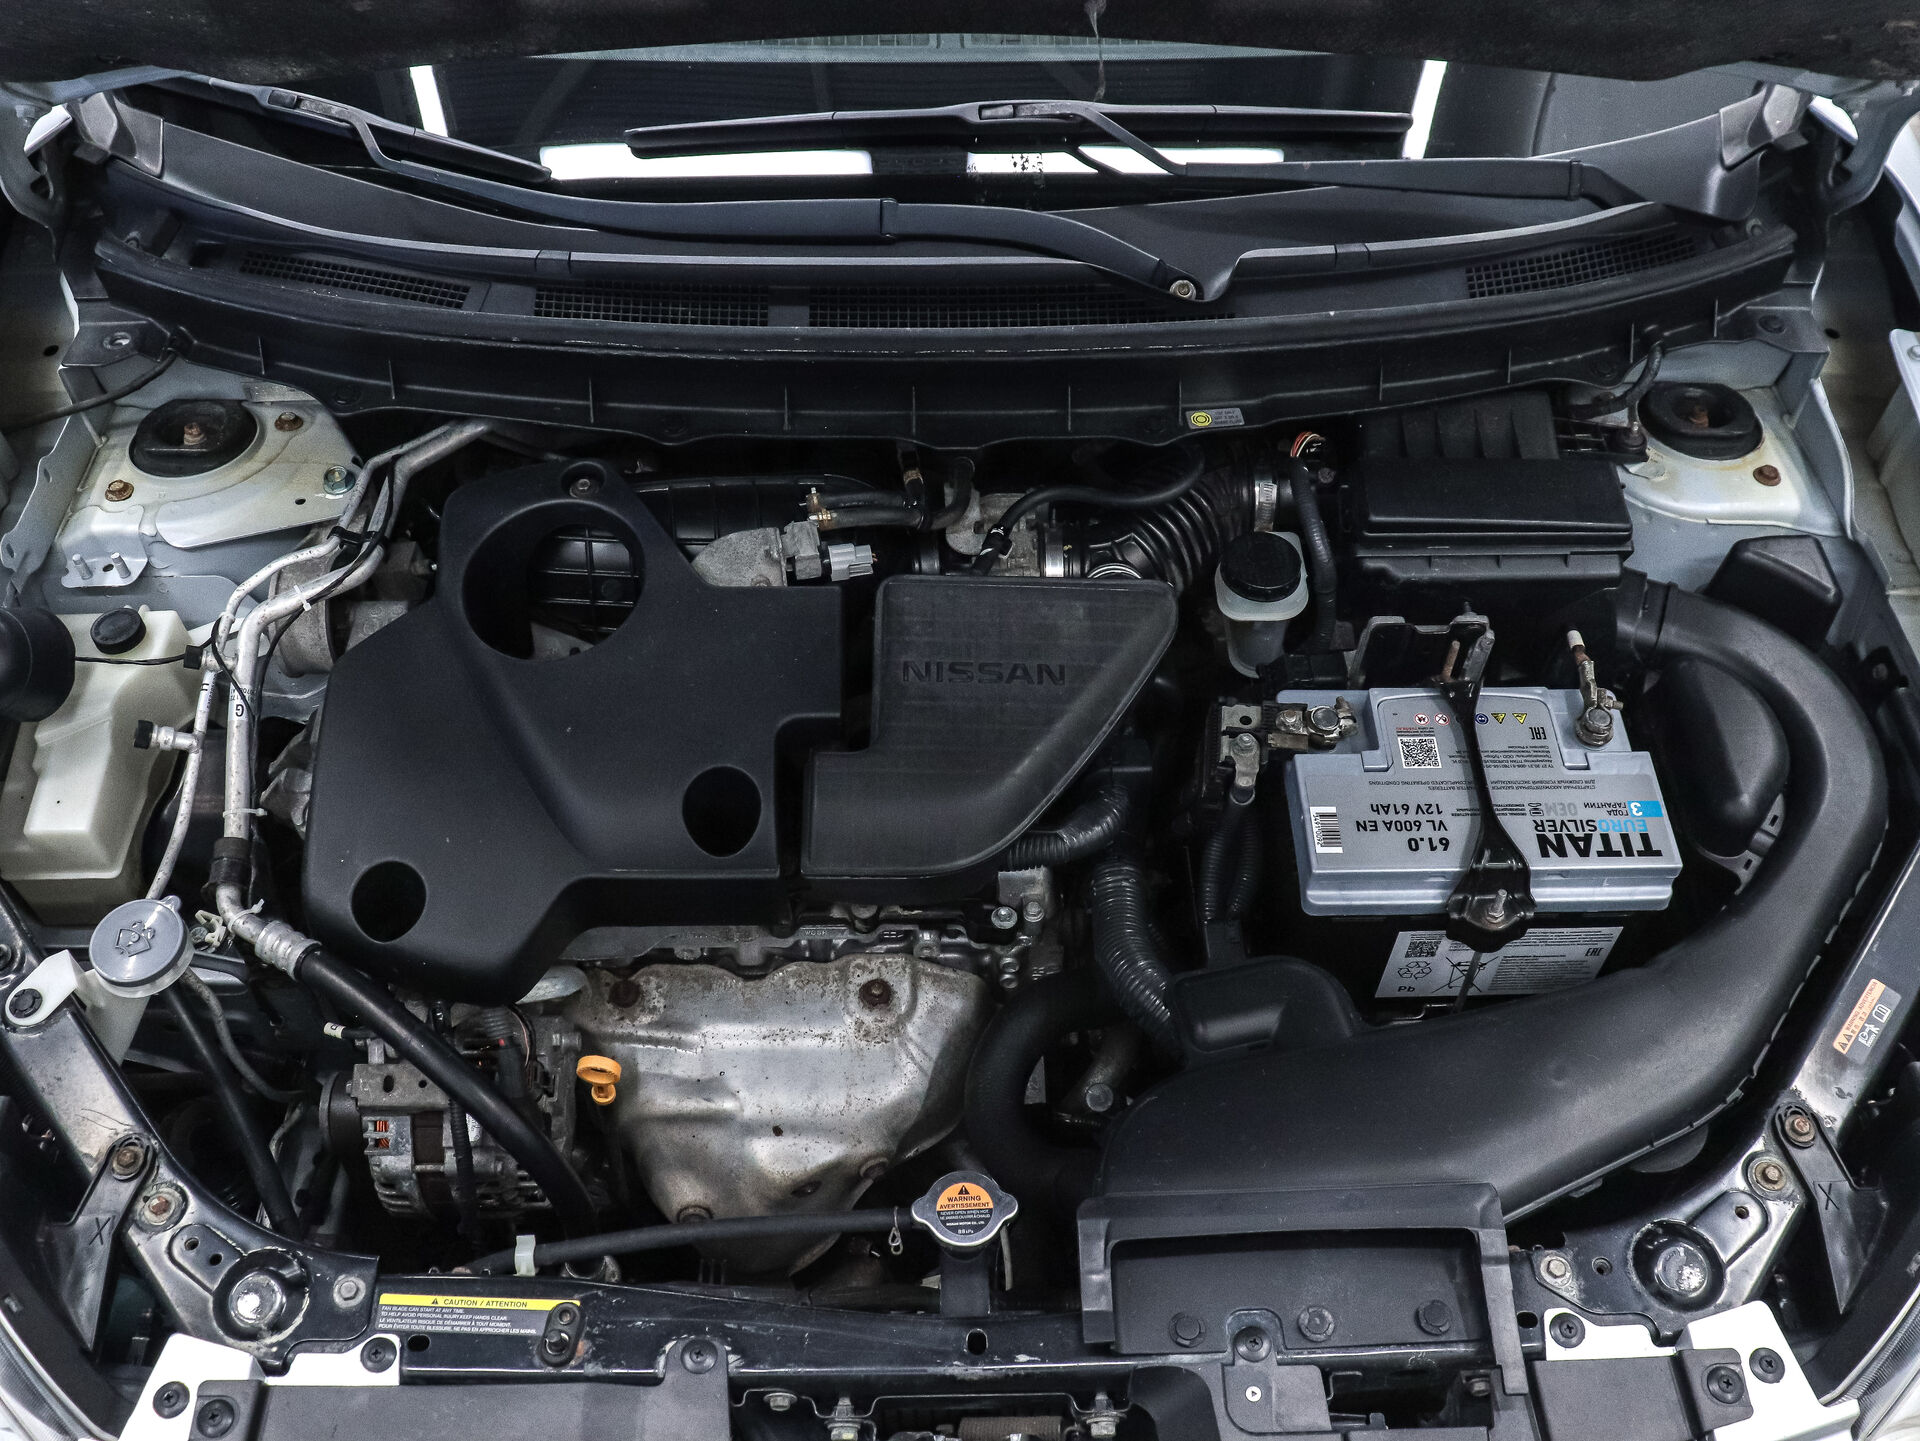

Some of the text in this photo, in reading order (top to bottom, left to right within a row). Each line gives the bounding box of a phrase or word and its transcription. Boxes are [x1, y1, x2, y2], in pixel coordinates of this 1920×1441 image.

[902, 660, 1066, 686] NISSAN
[1370, 803, 1443, 815] 12V 61Ah
[1543, 802, 1578, 817] OEM
[1606, 809, 1629, 817] ГОДА
[1630, 802, 1643, 816] 3
[1355, 820, 1448, 831] VL 600A EN
[1531, 819, 1649, 832] EUROSILVER
[1407, 836, 1450, 852] 61.0
[1535, 832, 1663, 857] TITAN
[1397, 985, 1416, 993] Pb
[946, 1195, 982, 1203] WARNING
[939, 1202, 990, 1210] AVERTISSEMENT
[443, 1298, 478, 1307] CAUTION
[486, 1300, 529, 1308] ATTENTION
